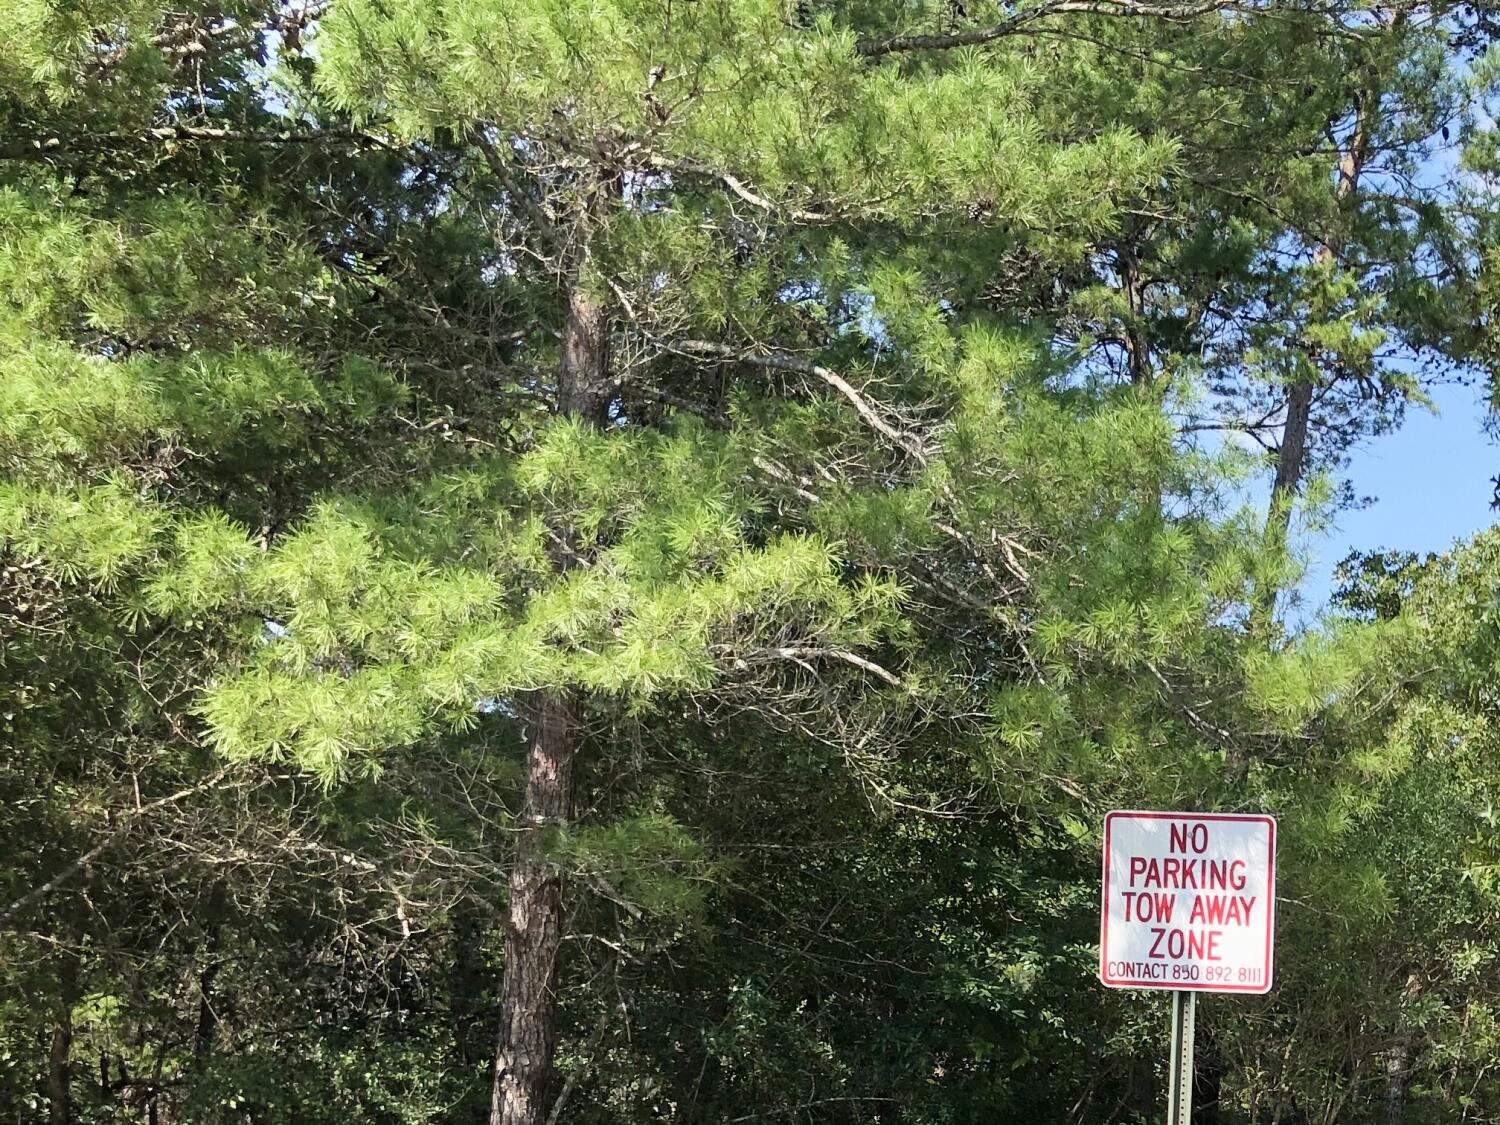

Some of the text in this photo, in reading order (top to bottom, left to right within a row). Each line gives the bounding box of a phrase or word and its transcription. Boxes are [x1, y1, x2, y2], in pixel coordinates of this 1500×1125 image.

[1169, 822, 1209, 854] NO
[1129, 857, 1246, 891] PARKING
[1121, 891, 1257, 927] TOW AWAY
[1148, 927, 1223, 961] ZONE
[1108, 961, 1262, 984] CONTACT 850 892 8111
